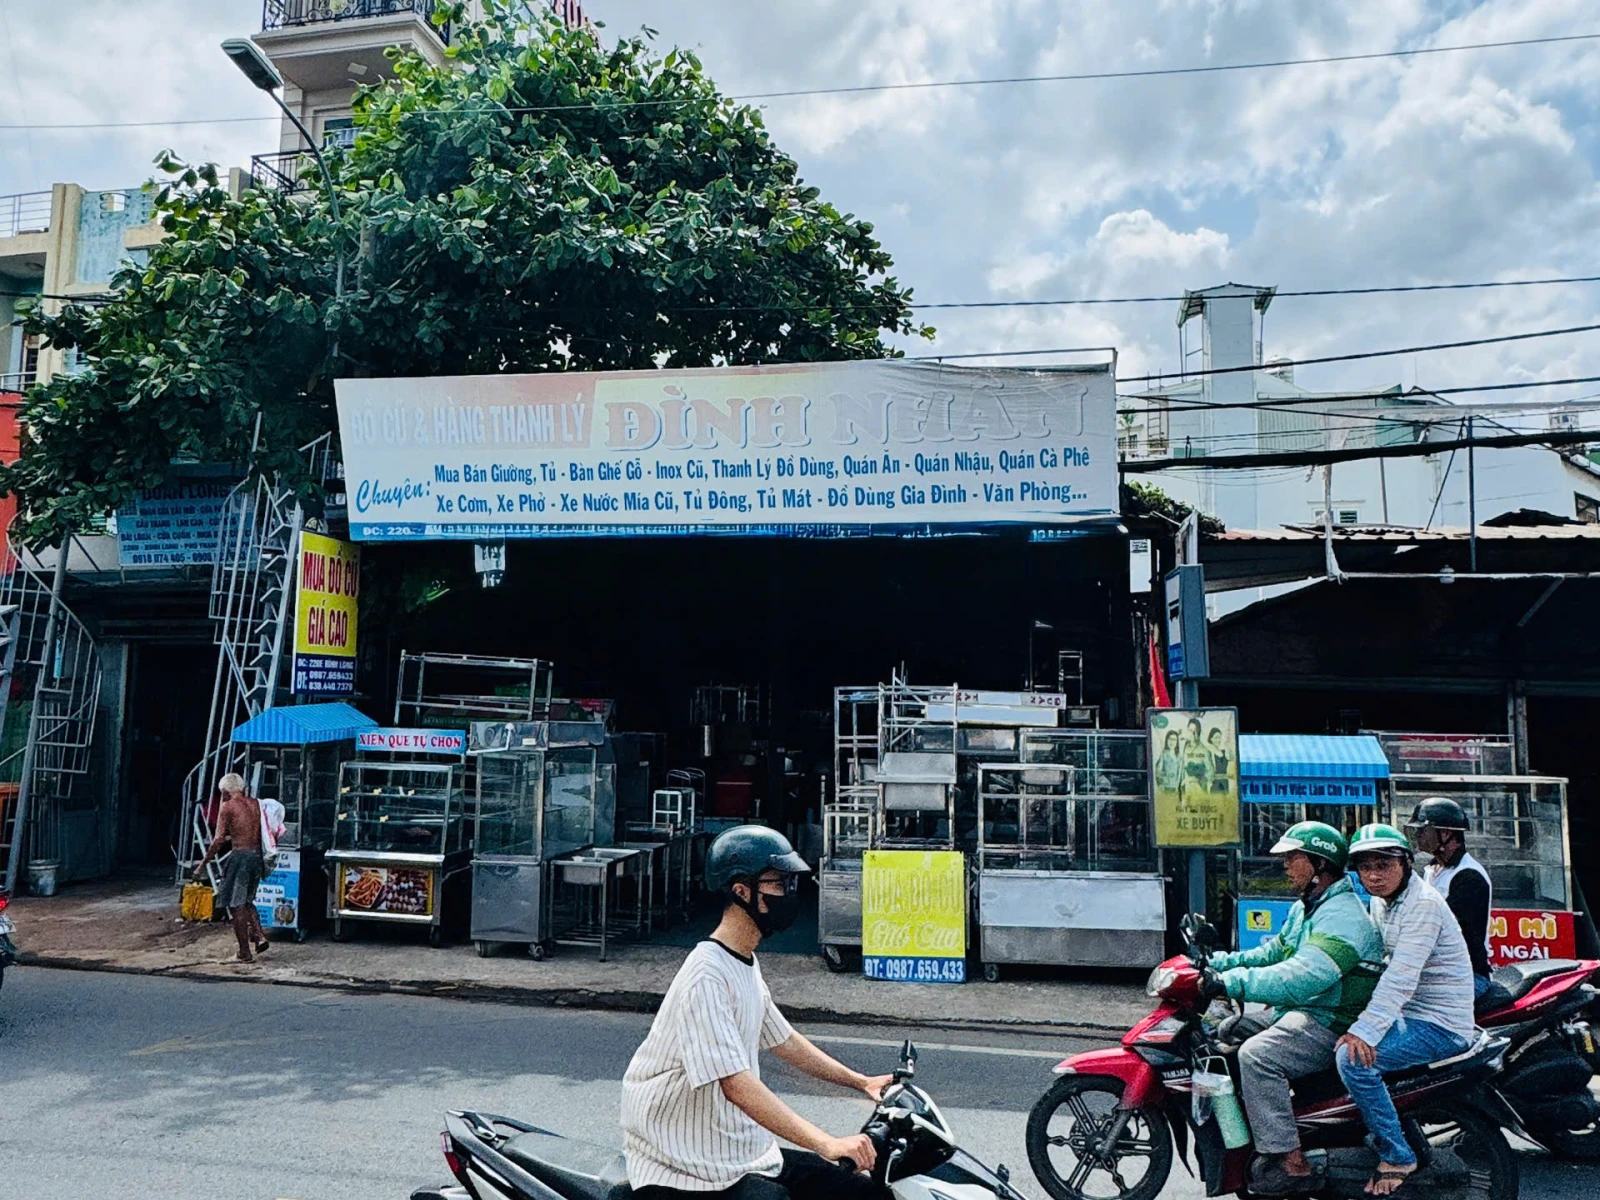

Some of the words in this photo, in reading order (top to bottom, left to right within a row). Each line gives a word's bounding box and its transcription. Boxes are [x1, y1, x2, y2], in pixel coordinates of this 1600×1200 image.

[433, 396, 484, 445] HÀNG
[489, 403, 554, 444] THANH
[561, 393, 586, 442] LÝ
[603, 385, 812, 451] ĐÌNH
[434, 464, 460, 482] Mua
[464, 463, 487, 483] Bán
[490, 463, 537, 486] Giường,
[540, 460, 556, 481] Tủ
[569, 461, 594, 481] Bàn
[598, 459, 622, 481] Ghế
[626, 457, 643, 481] Gỗ
[656, 460, 683, 480] Inox
[686, 458, 708, 482] Cũ,
[712, 458, 752, 479] Thanh
[756, 457, 772, 481] Lý
[776, 454, 795, 477] Đồ
[800, 456, 839, 480] Dùng,
[843, 454, 878, 478] Quán
[882, 449, 901, 475] Ăn
[914, 452, 950, 476] Quán
[954, 451, 995, 476] Nhậu,
[999, 449, 1035, 474] Quán
[1039, 447, 1058, 470] Cà
[1063, 446, 1090, 468] Phê
[355, 478, 431, 513] Chuyên:
[436, 495, 454, 513] Xe
[458, 493, 493, 516] Cơm,
[497, 494, 514, 512] Xe
[519, 491, 546, 512] Phở
[560, 493, 578, 512] Xe
[582, 491, 619, 512] Nước
[623, 490, 650, 511] Mía
[654, 490, 679, 513] Cũ,
[684, 488, 703, 510] Tủ
[708, 490, 753, 513] Đông,
[757, 487, 776, 509] Tủ
[782, 487, 812, 508] Mát
[827, 484, 849, 508] Đồ
[855, 486, 896, 509] Dùng
[901, 485, 926, 505] Gia
[931, 483, 967, 504] Đình
[983, 481, 1014, 503] Văn
[303, 551, 325, 592] MUA
[308, 599, 326, 646] GIÁ
[328, 609, 348, 648] CAO
[388, 734, 410, 749] QUE
[1176, 817, 1189, 830] XE
[1311, 837, 1338, 854] Grab
[1519, 913, 1557, 940] MÌ
[865, 959, 884, 976] ĐT:
[886, 959, 964, 980] 0987.659.433
